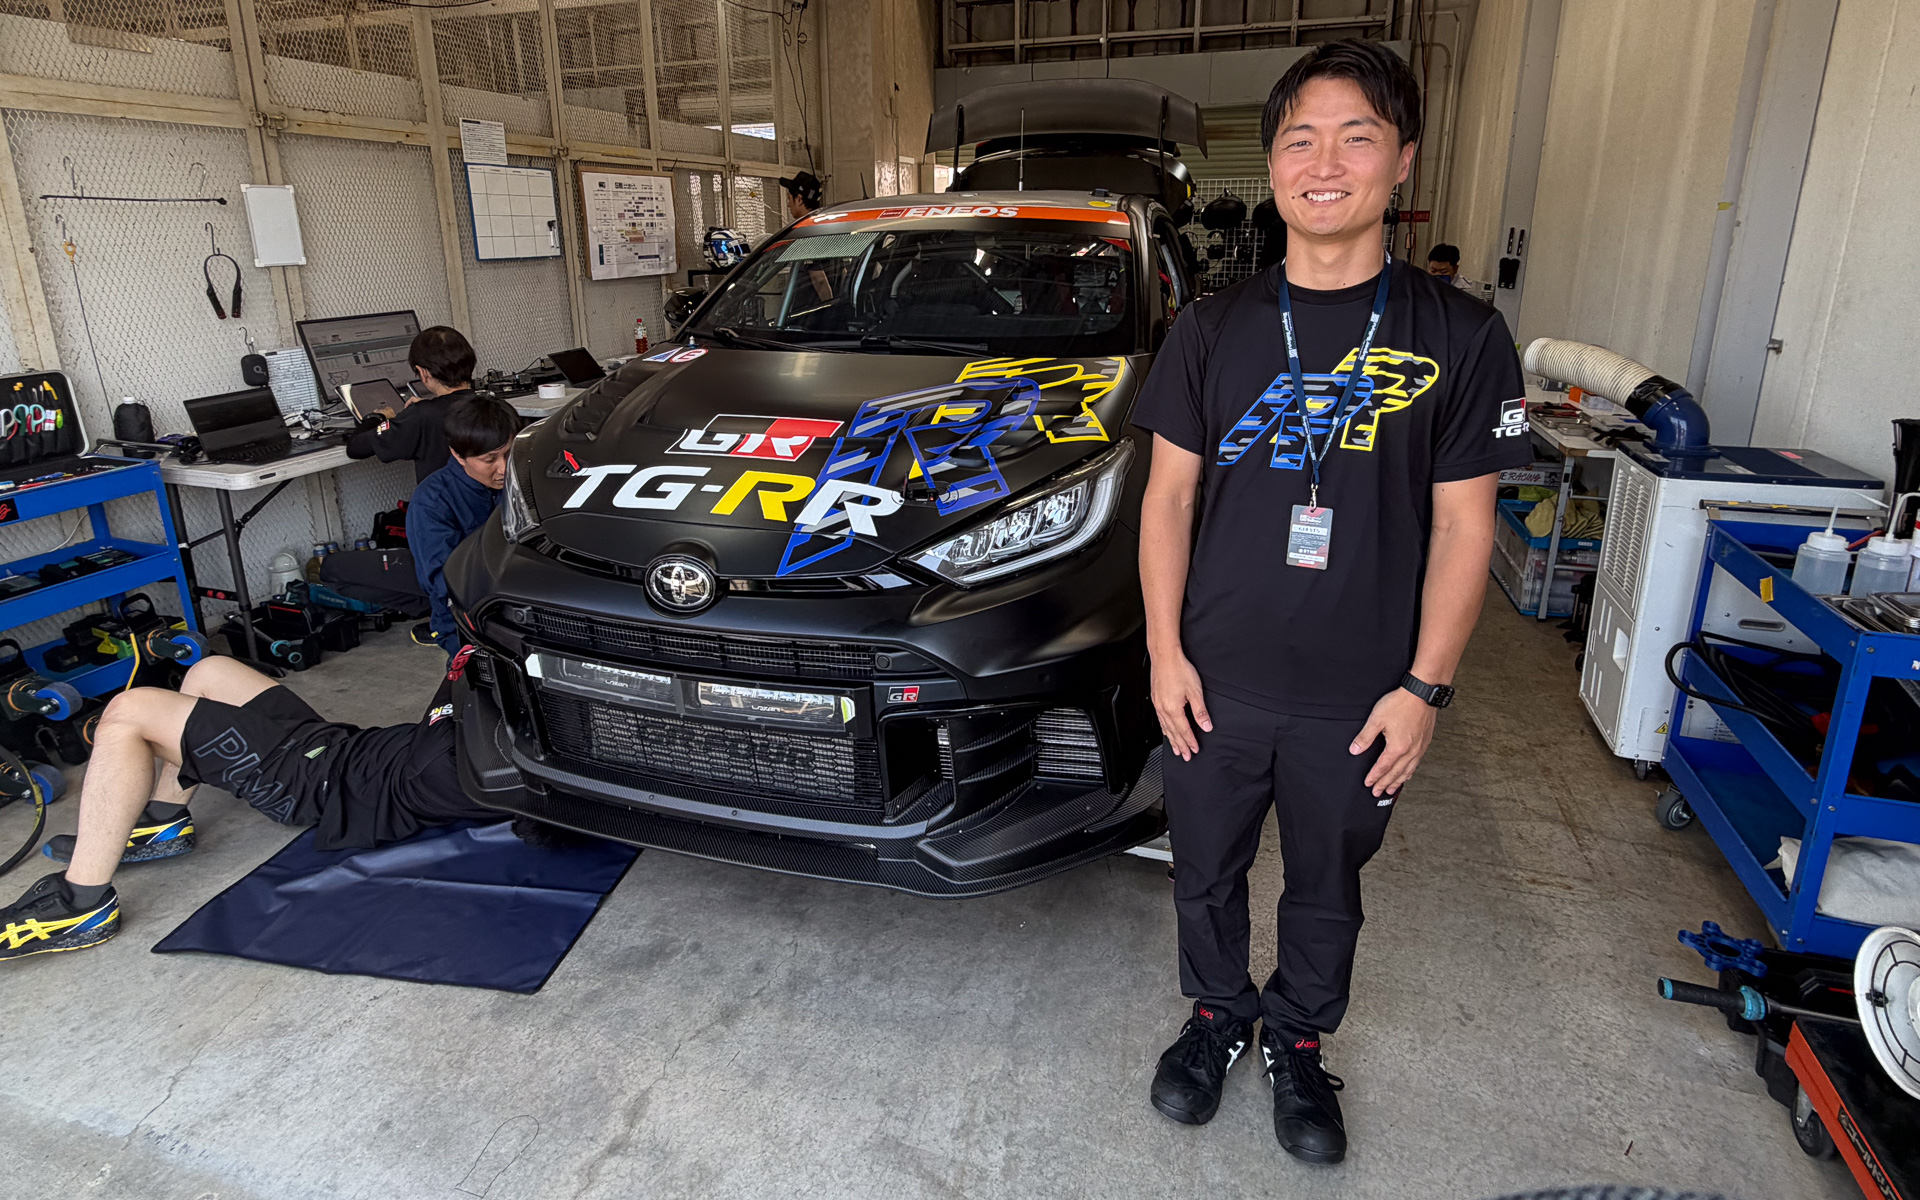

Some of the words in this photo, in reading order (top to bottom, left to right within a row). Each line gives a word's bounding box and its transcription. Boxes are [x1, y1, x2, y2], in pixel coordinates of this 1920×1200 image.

[905, 206, 1019, 218] ENEOS
[679, 429, 810, 457] GR
[562, 464, 905, 537] TG-RR
[889, 692, 917, 701] GR
[193, 726, 297, 823] PUMA
